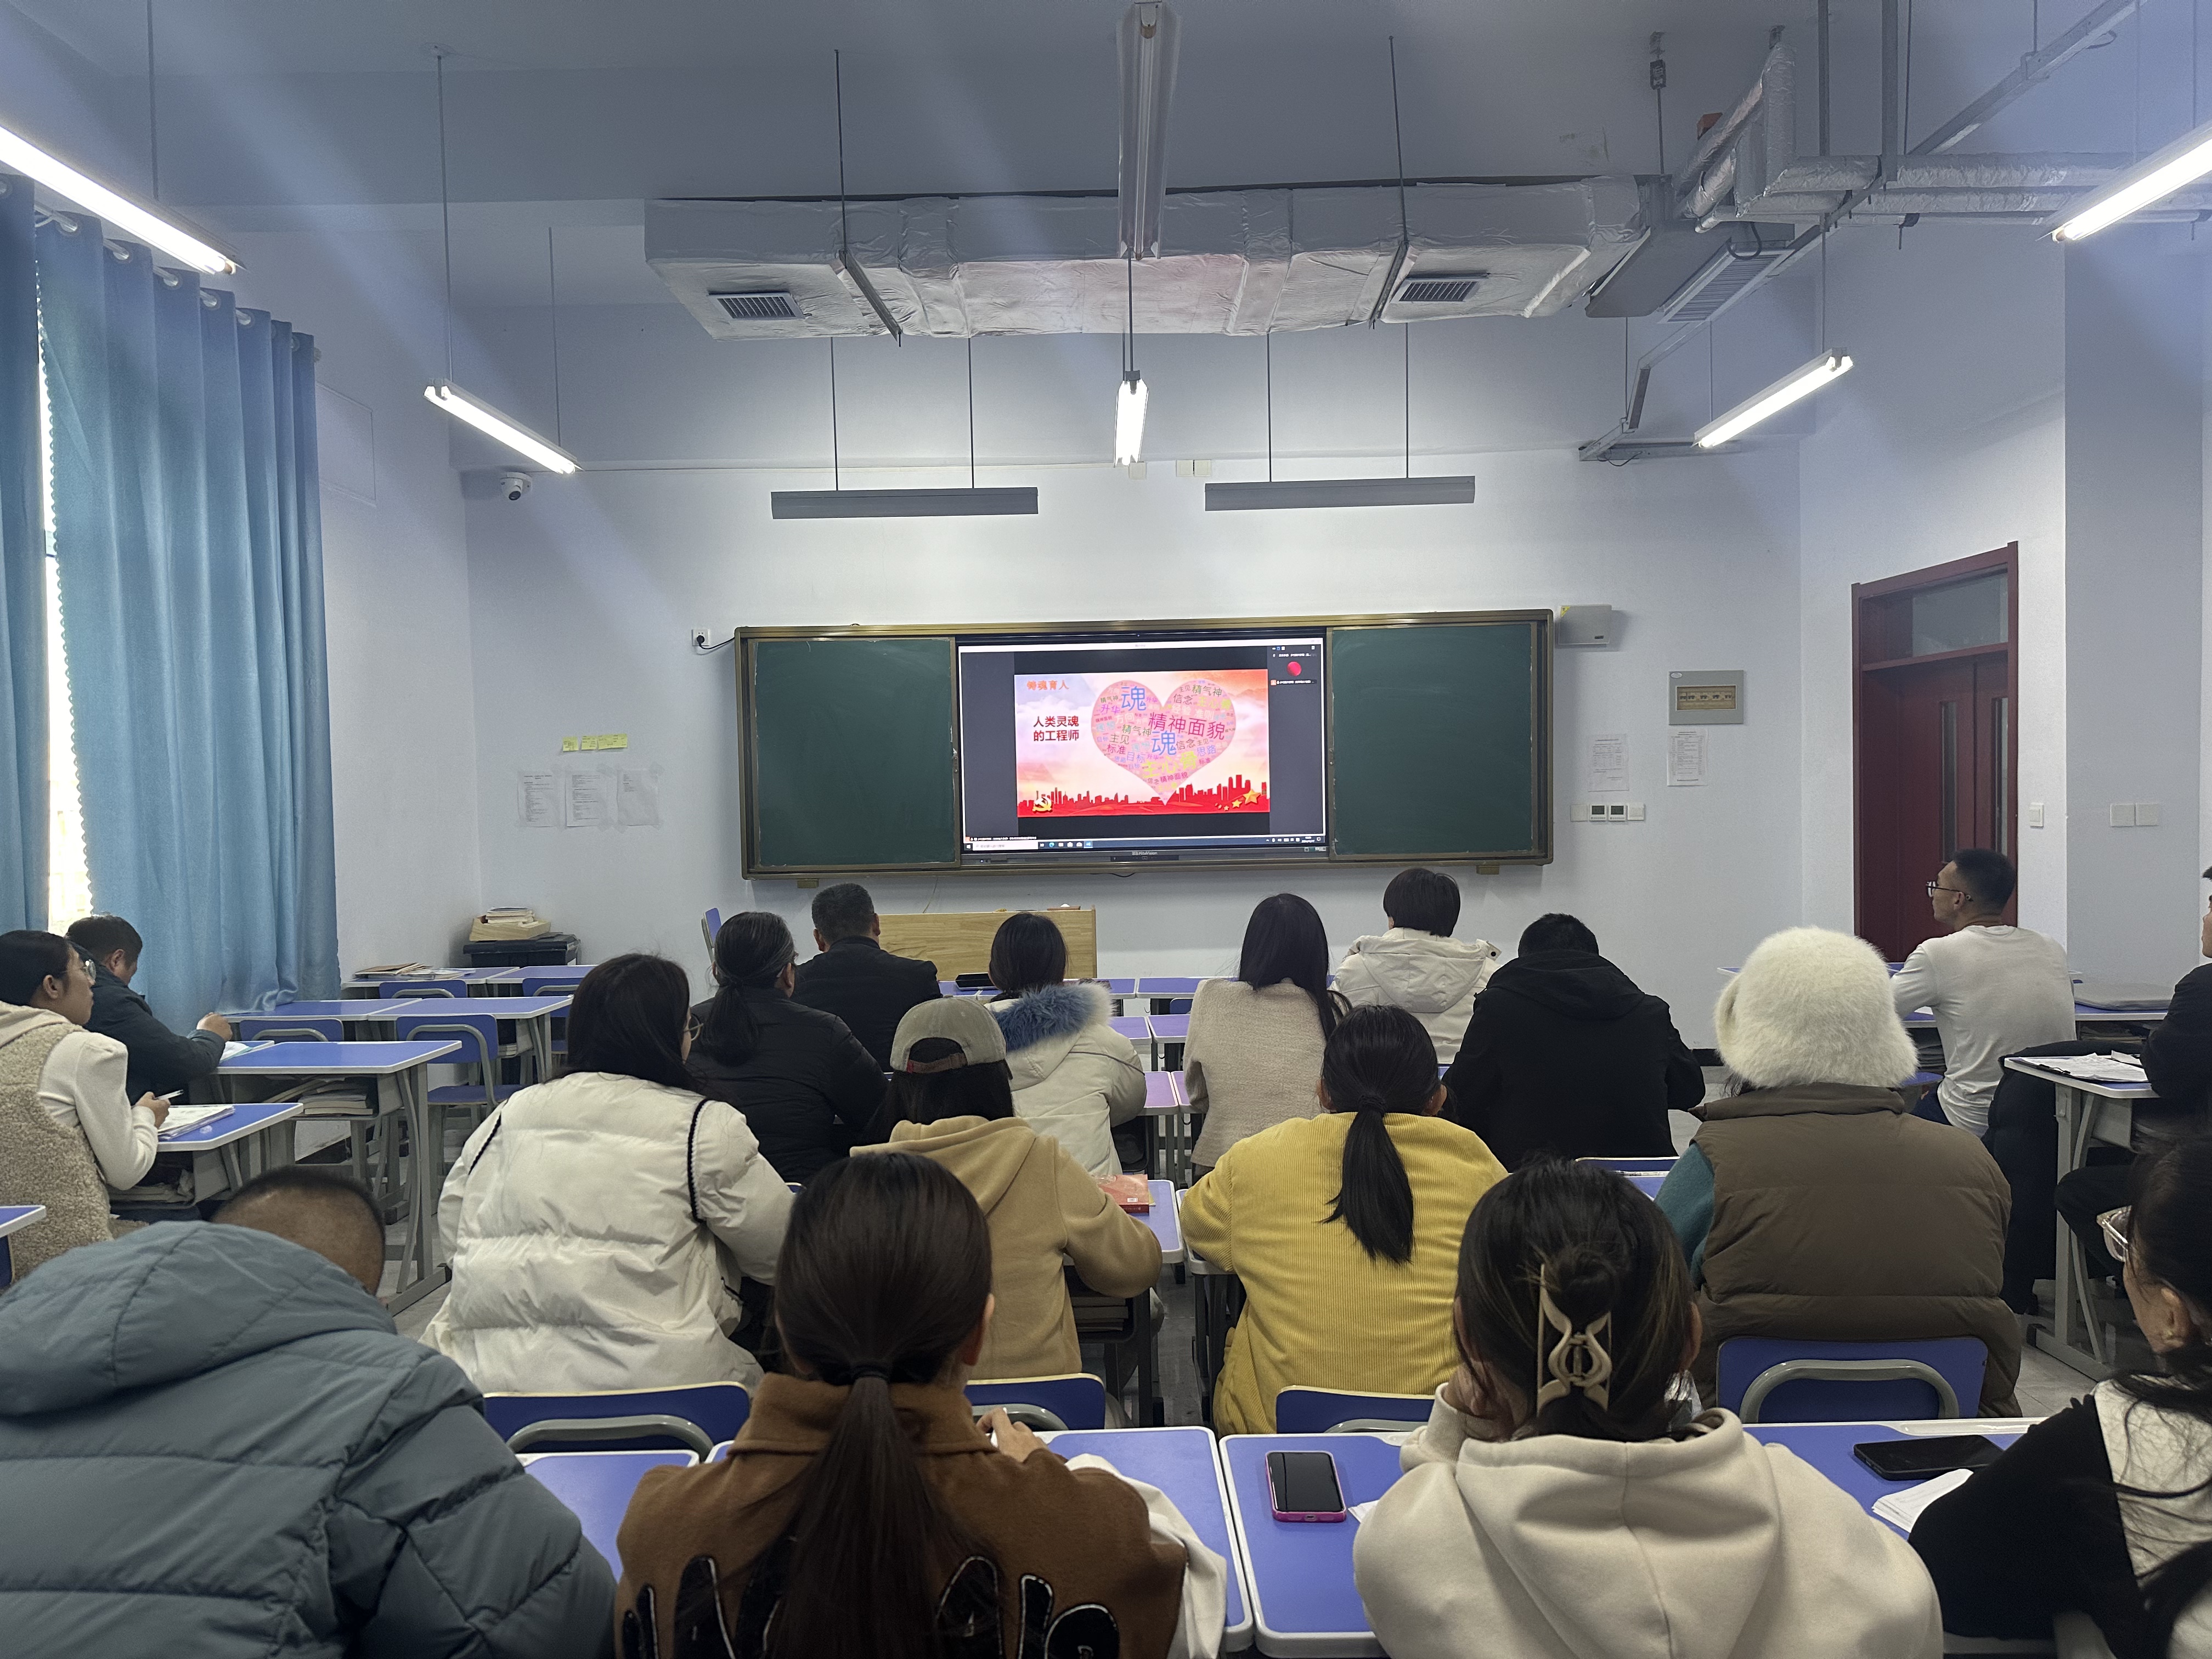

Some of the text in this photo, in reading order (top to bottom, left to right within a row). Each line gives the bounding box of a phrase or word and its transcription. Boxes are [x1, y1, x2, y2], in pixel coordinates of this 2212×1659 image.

[1192, 685, 1222, 697] 精气神
[1121, 686, 1147, 711] 魂
[1173, 693, 1193, 705] 信念
[1101, 704, 1121, 715] 升华
[1034, 715, 1079, 727] 人类灵魂
[1148, 712, 1225, 740] 精神面貌
[1034, 730, 1079, 741] 的工程师
[1122, 724, 1152, 737] 精气神
[1109, 733, 1130, 745] 主见
[1151, 730, 1177, 755] 魂
[1176, 738, 1195, 751] 信念
[1107, 743, 1126, 754] 标准
[1197, 745, 1216, 757] 思路
[1127, 752, 1146, 763] 目标
[1141, 751, 1197, 778] 主心骨
[1160, 772, 1188, 783] 精神面貌
